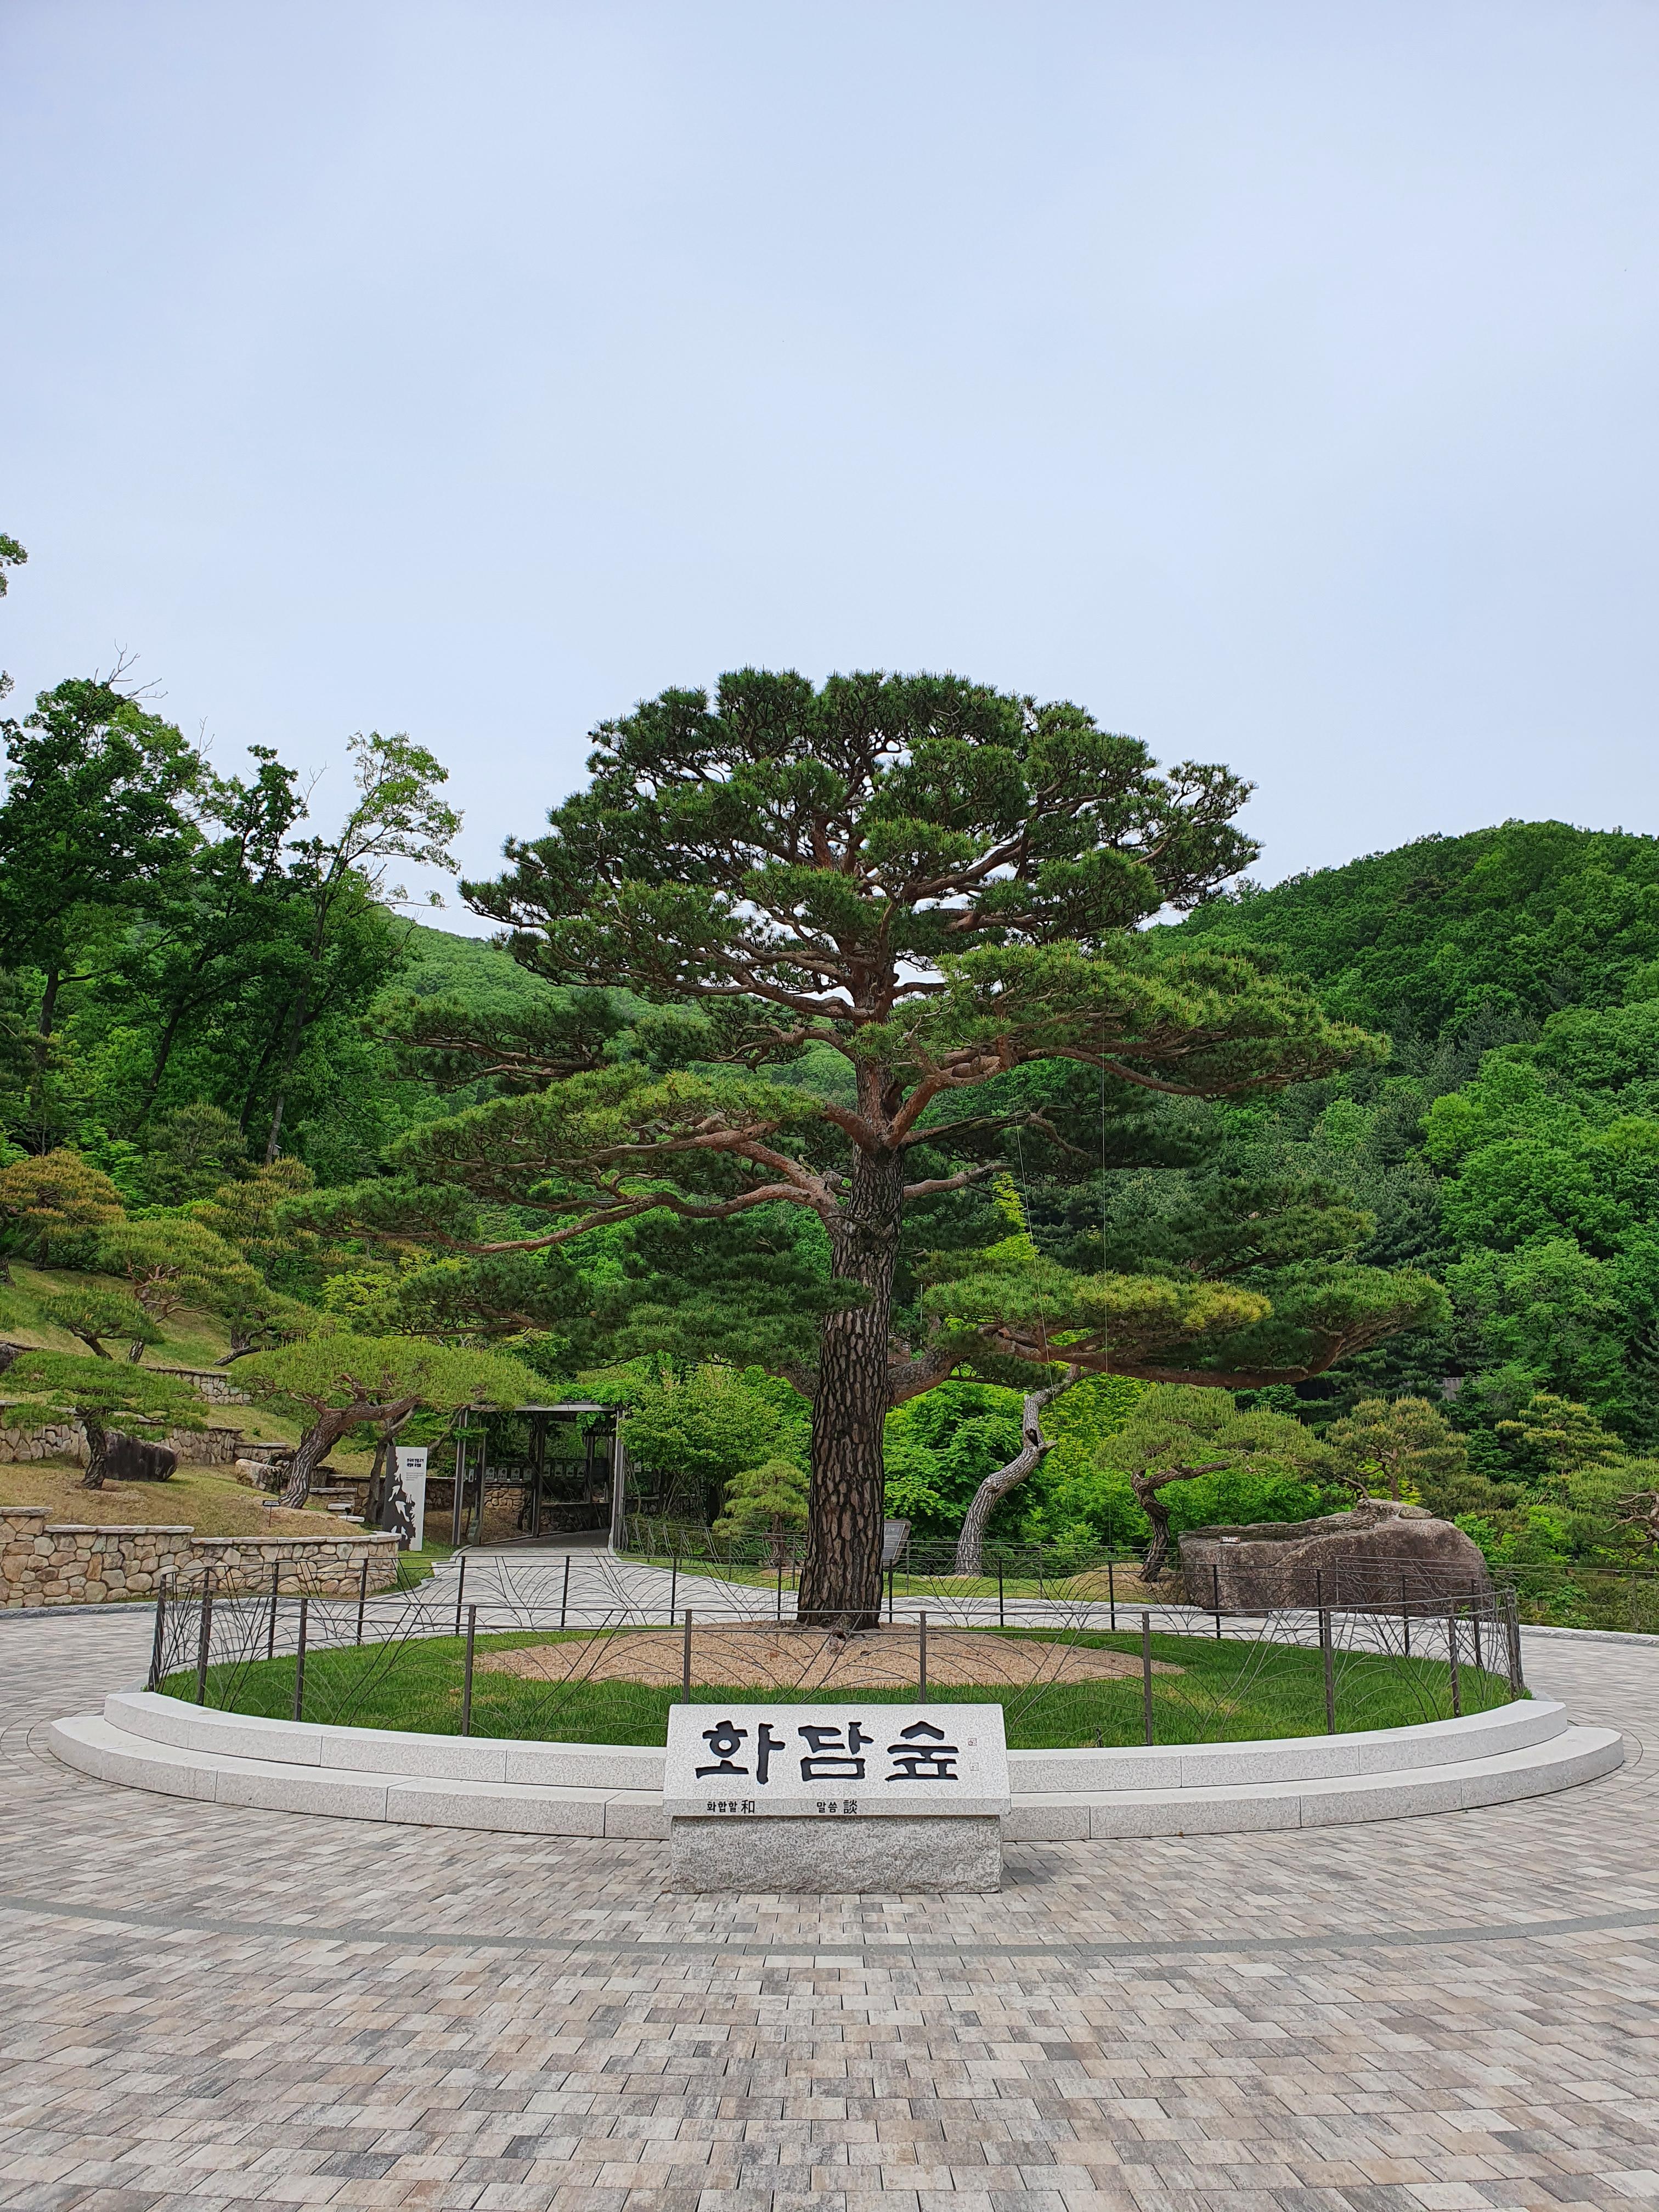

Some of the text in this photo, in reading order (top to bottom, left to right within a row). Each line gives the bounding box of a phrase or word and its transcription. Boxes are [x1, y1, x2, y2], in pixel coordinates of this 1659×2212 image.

[695, 1720, 960, 1785] 화담숲
[707, 1799, 755, 1814] 화합할 和
[816, 1799, 857, 1814] 말씀 談
